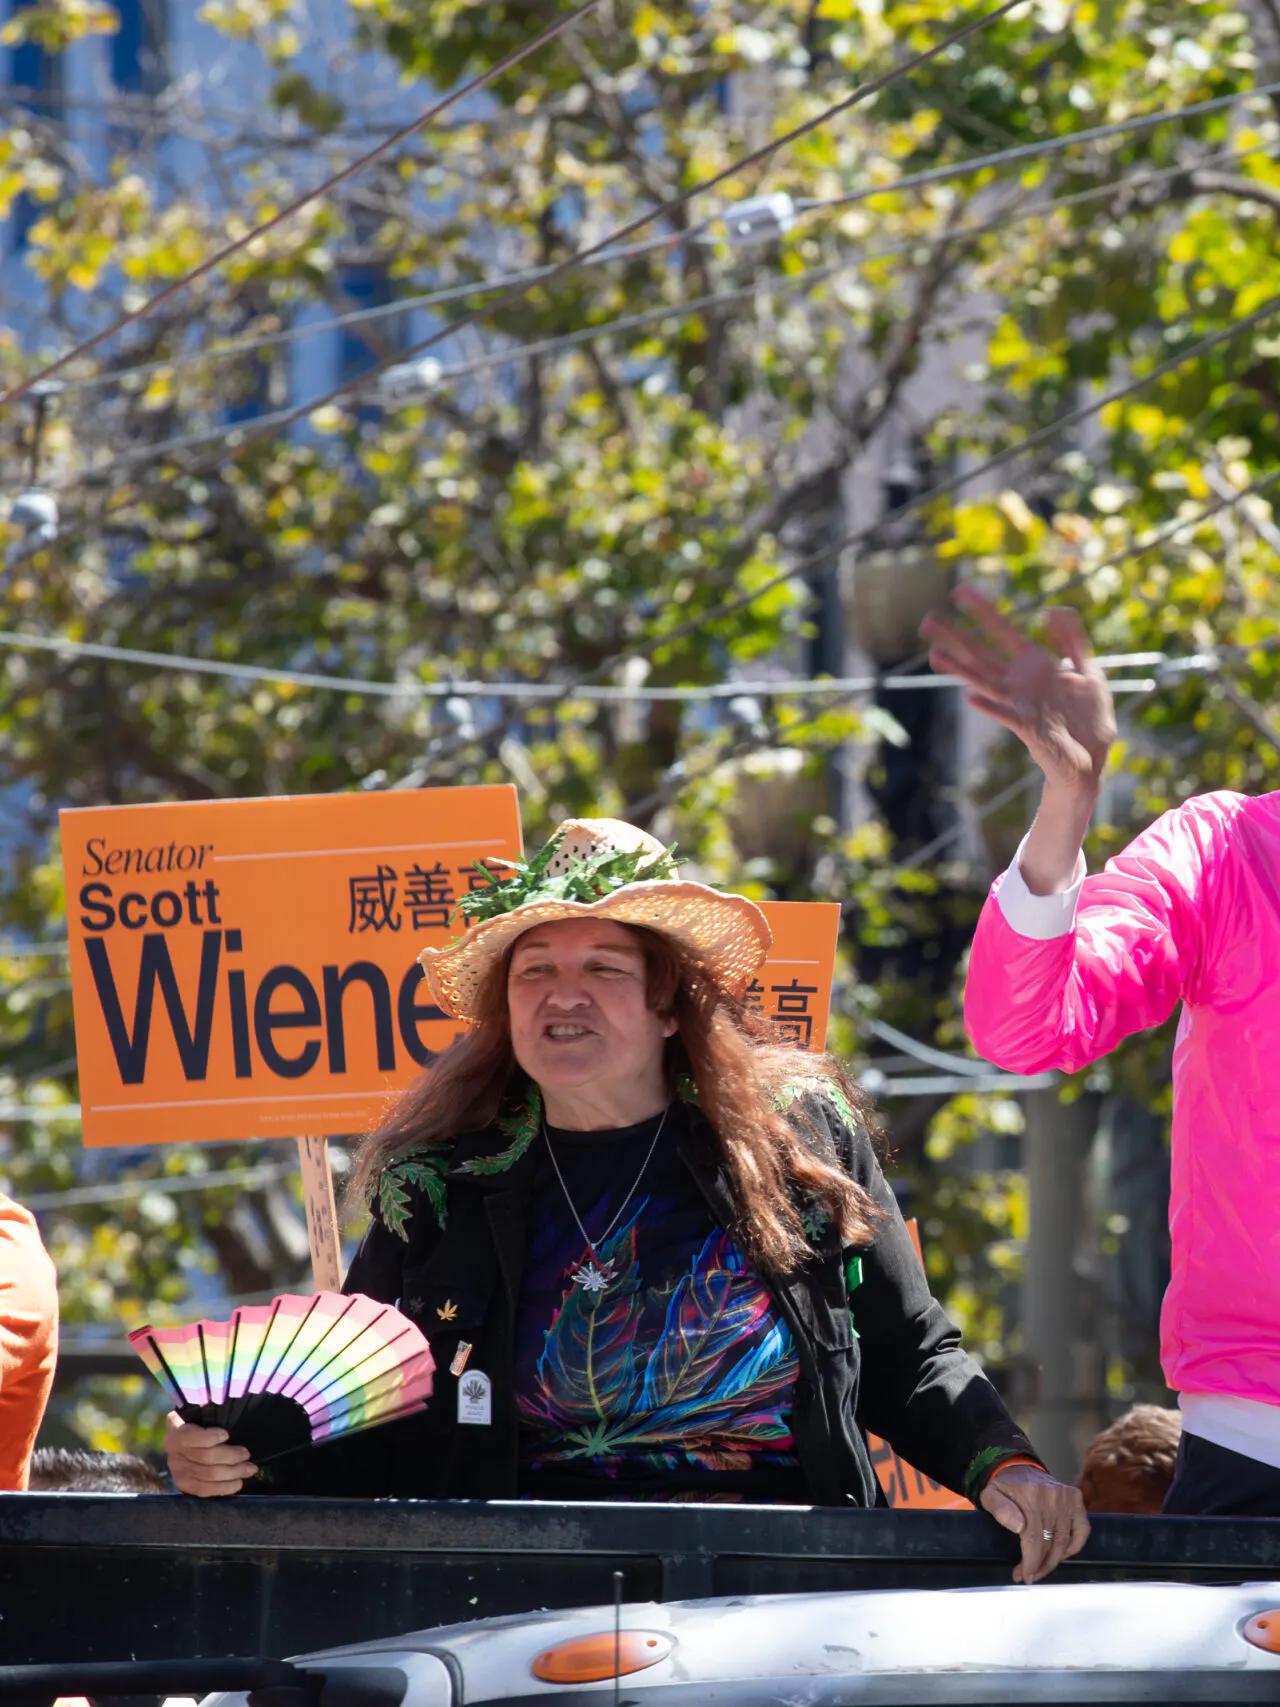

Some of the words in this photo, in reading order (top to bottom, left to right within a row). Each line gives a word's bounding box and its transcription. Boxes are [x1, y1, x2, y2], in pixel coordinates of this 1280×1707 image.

[82, 838, 214, 876] Senator
[80, 880, 222, 931] Scott
[84, 928, 466, 1085] Wiene
